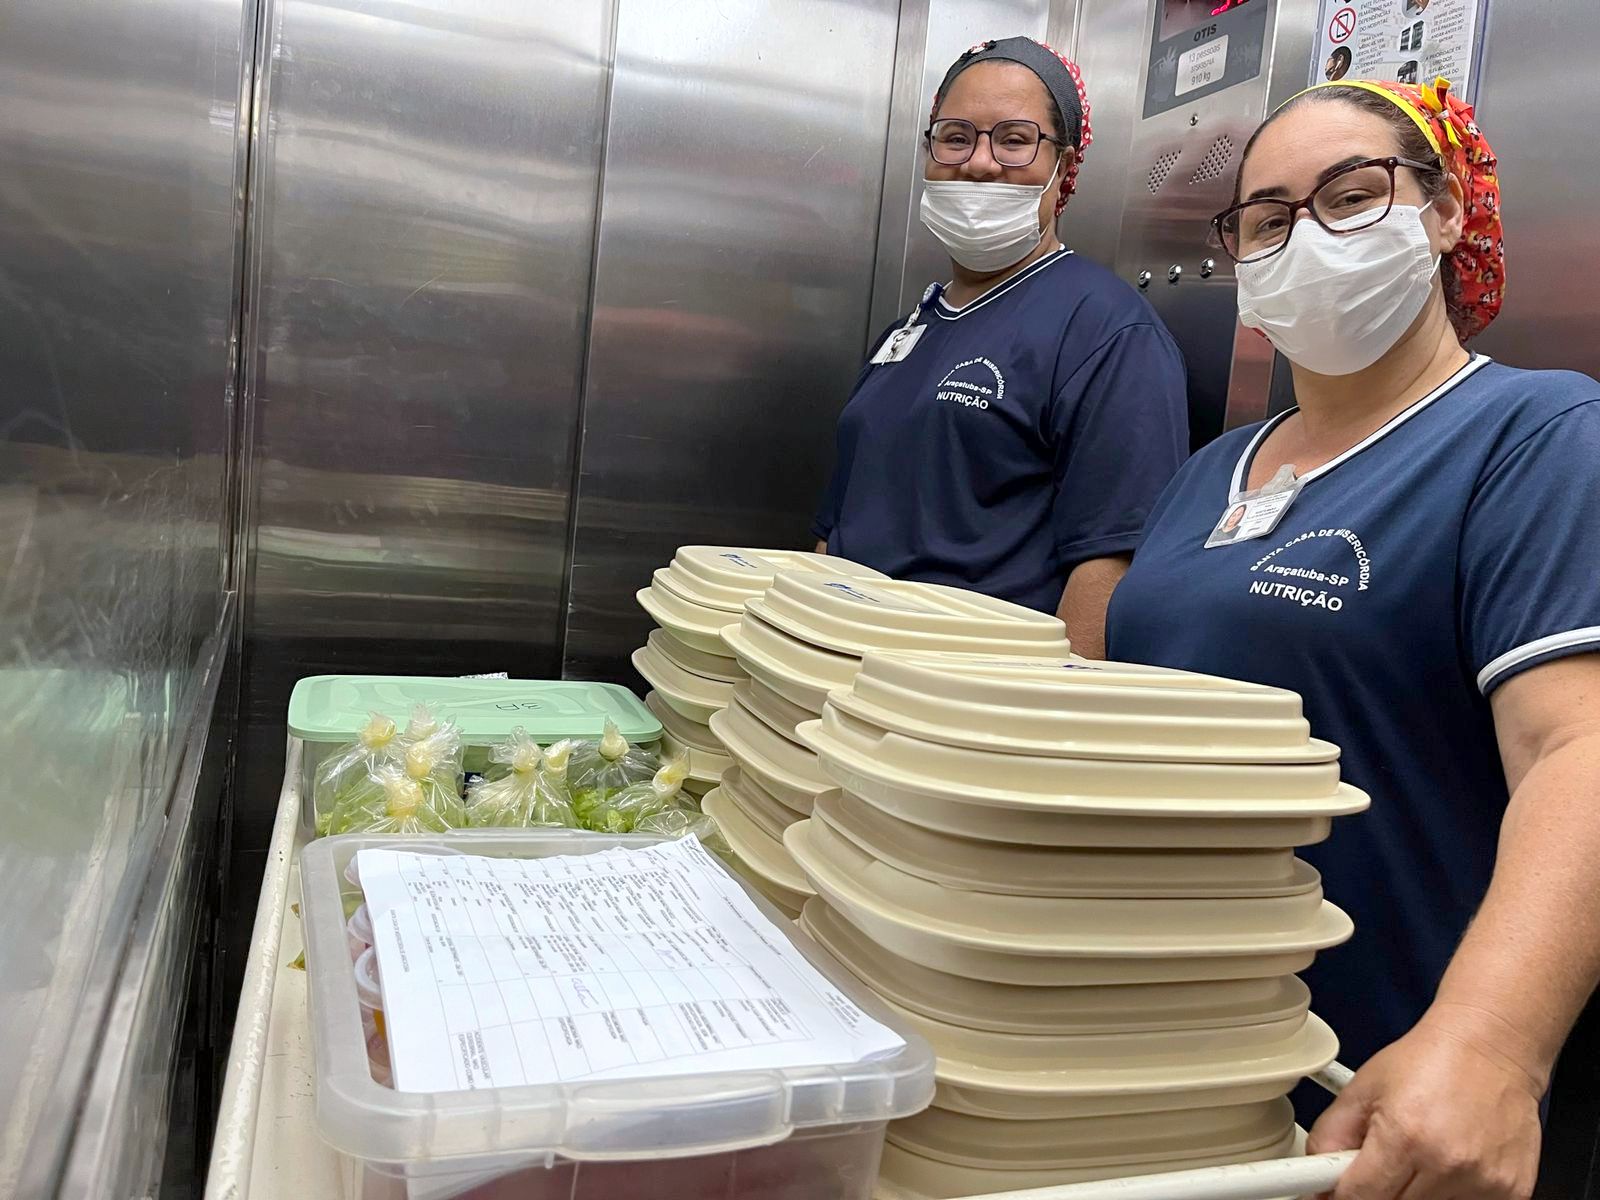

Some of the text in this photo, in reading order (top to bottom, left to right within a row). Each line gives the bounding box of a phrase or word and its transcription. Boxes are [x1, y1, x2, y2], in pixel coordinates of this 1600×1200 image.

[1193, 23, 1217, 42] OTIS
[936, 391, 989, 410] NUTRIÇÃO
[1285, 530, 1316, 548] CASA
[1317, 528, 1335, 538] DE
[1264, 564, 1349, 587] Araçatuba-SP
[1249, 580, 1343, 612] NUTRIÇÃO
